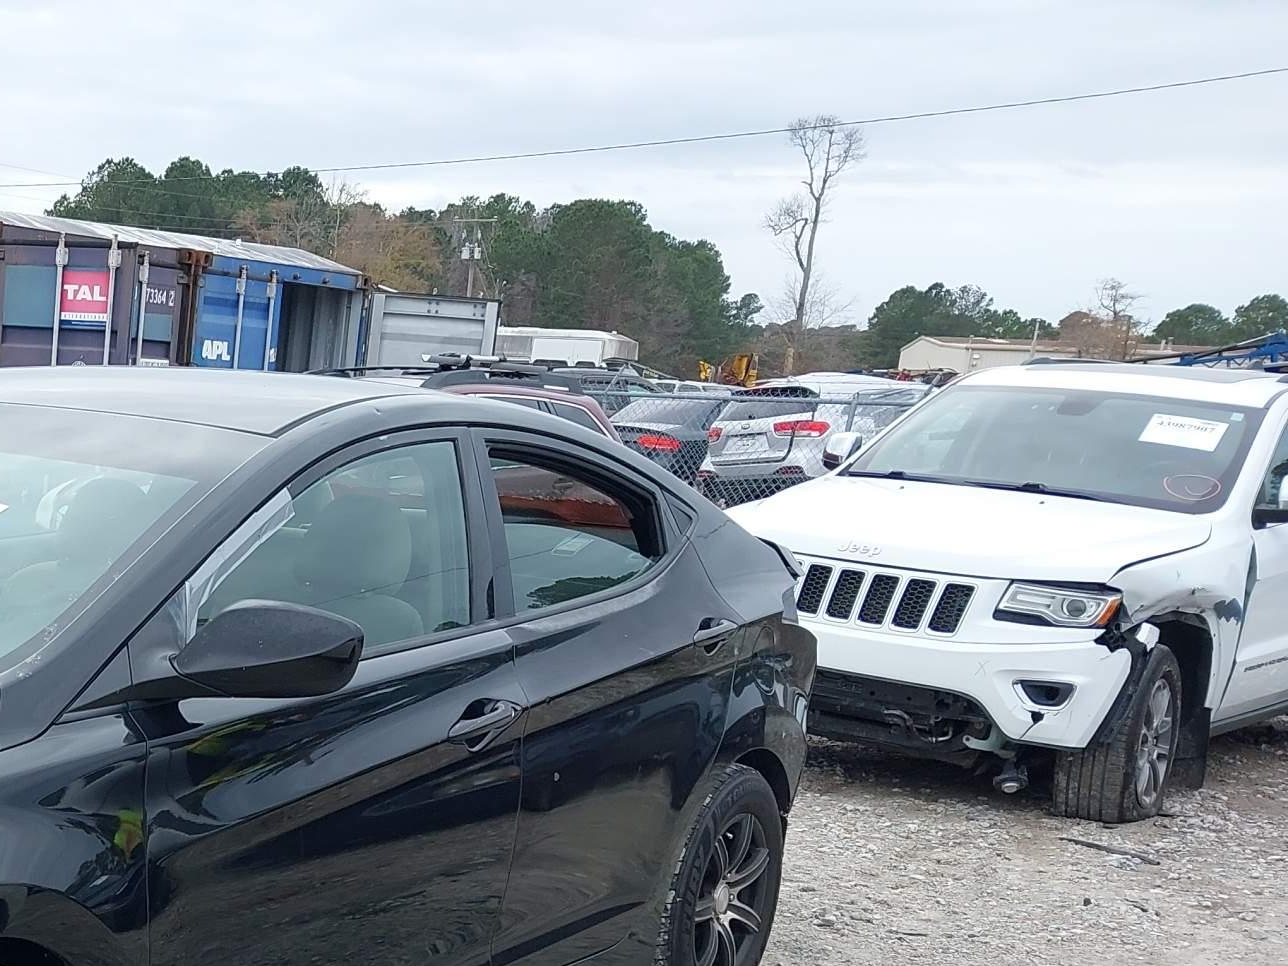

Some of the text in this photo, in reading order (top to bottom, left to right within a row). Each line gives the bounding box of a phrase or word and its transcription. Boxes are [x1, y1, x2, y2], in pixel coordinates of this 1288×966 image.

[63, 284, 107, 301] TAL
[202, 339, 231, 361] APL
[837, 538, 882, 559] Jeep
